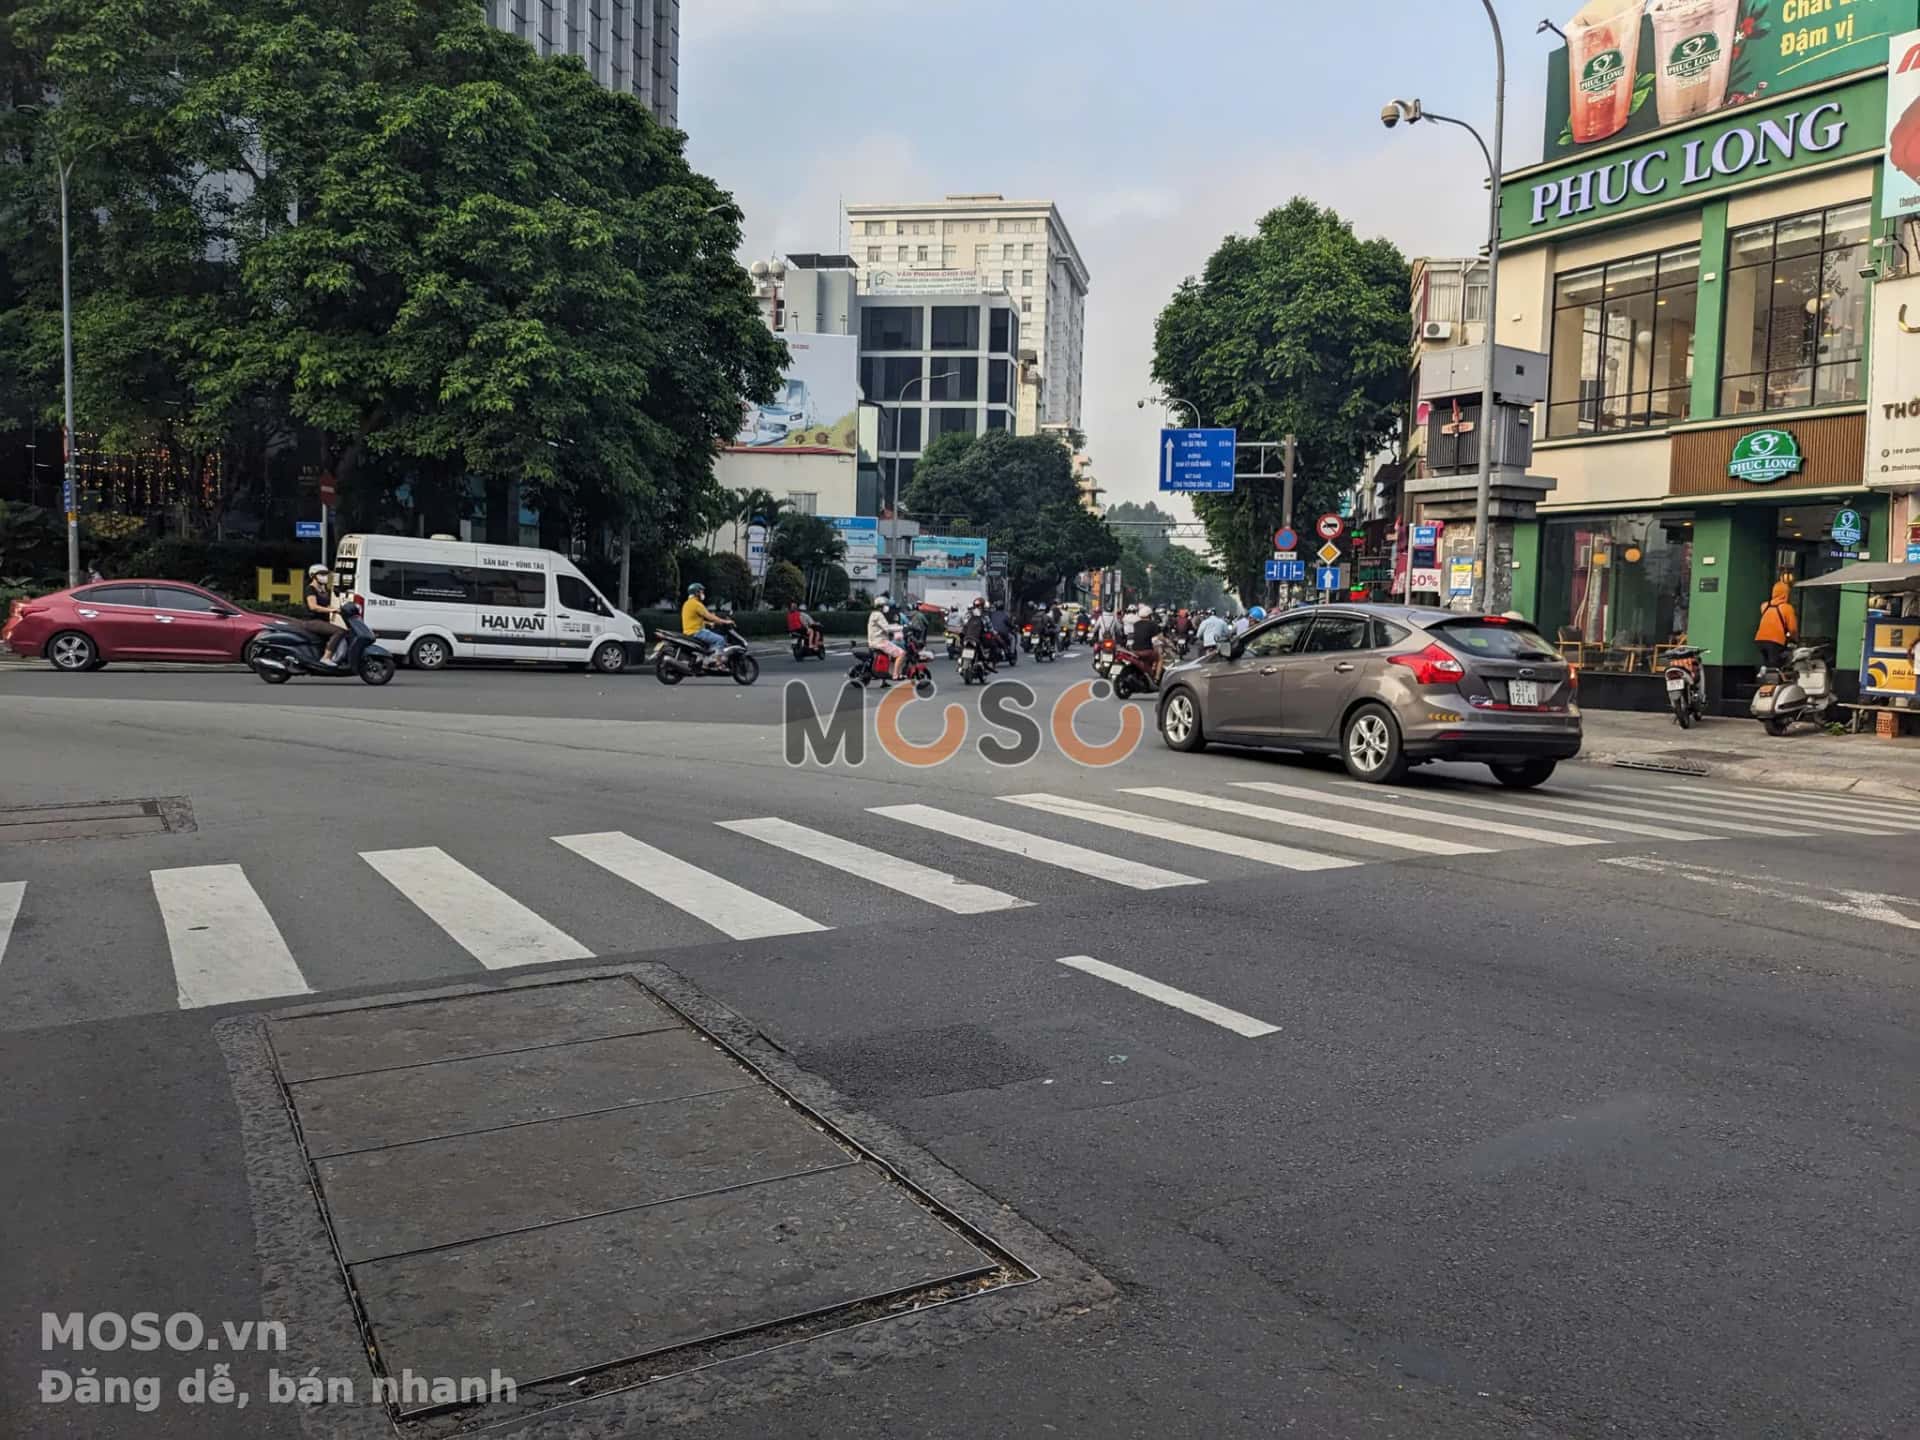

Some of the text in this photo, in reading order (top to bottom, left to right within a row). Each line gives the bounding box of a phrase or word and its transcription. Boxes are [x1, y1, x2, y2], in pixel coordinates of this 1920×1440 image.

[1780, 13, 1854, 57] Đậm vị
[1667, 61, 1693, 75] PHUC
[1694, 51, 1720, 67] LONG
[1580, 77, 1601, 91] PHUC
[1602, 69, 1624, 83] LONG
[1528, 101, 1848, 226] PHUC LONG
[1730, 459, 1797, 474] PHUC LONG
[481, 614, 509, 629] HAI
